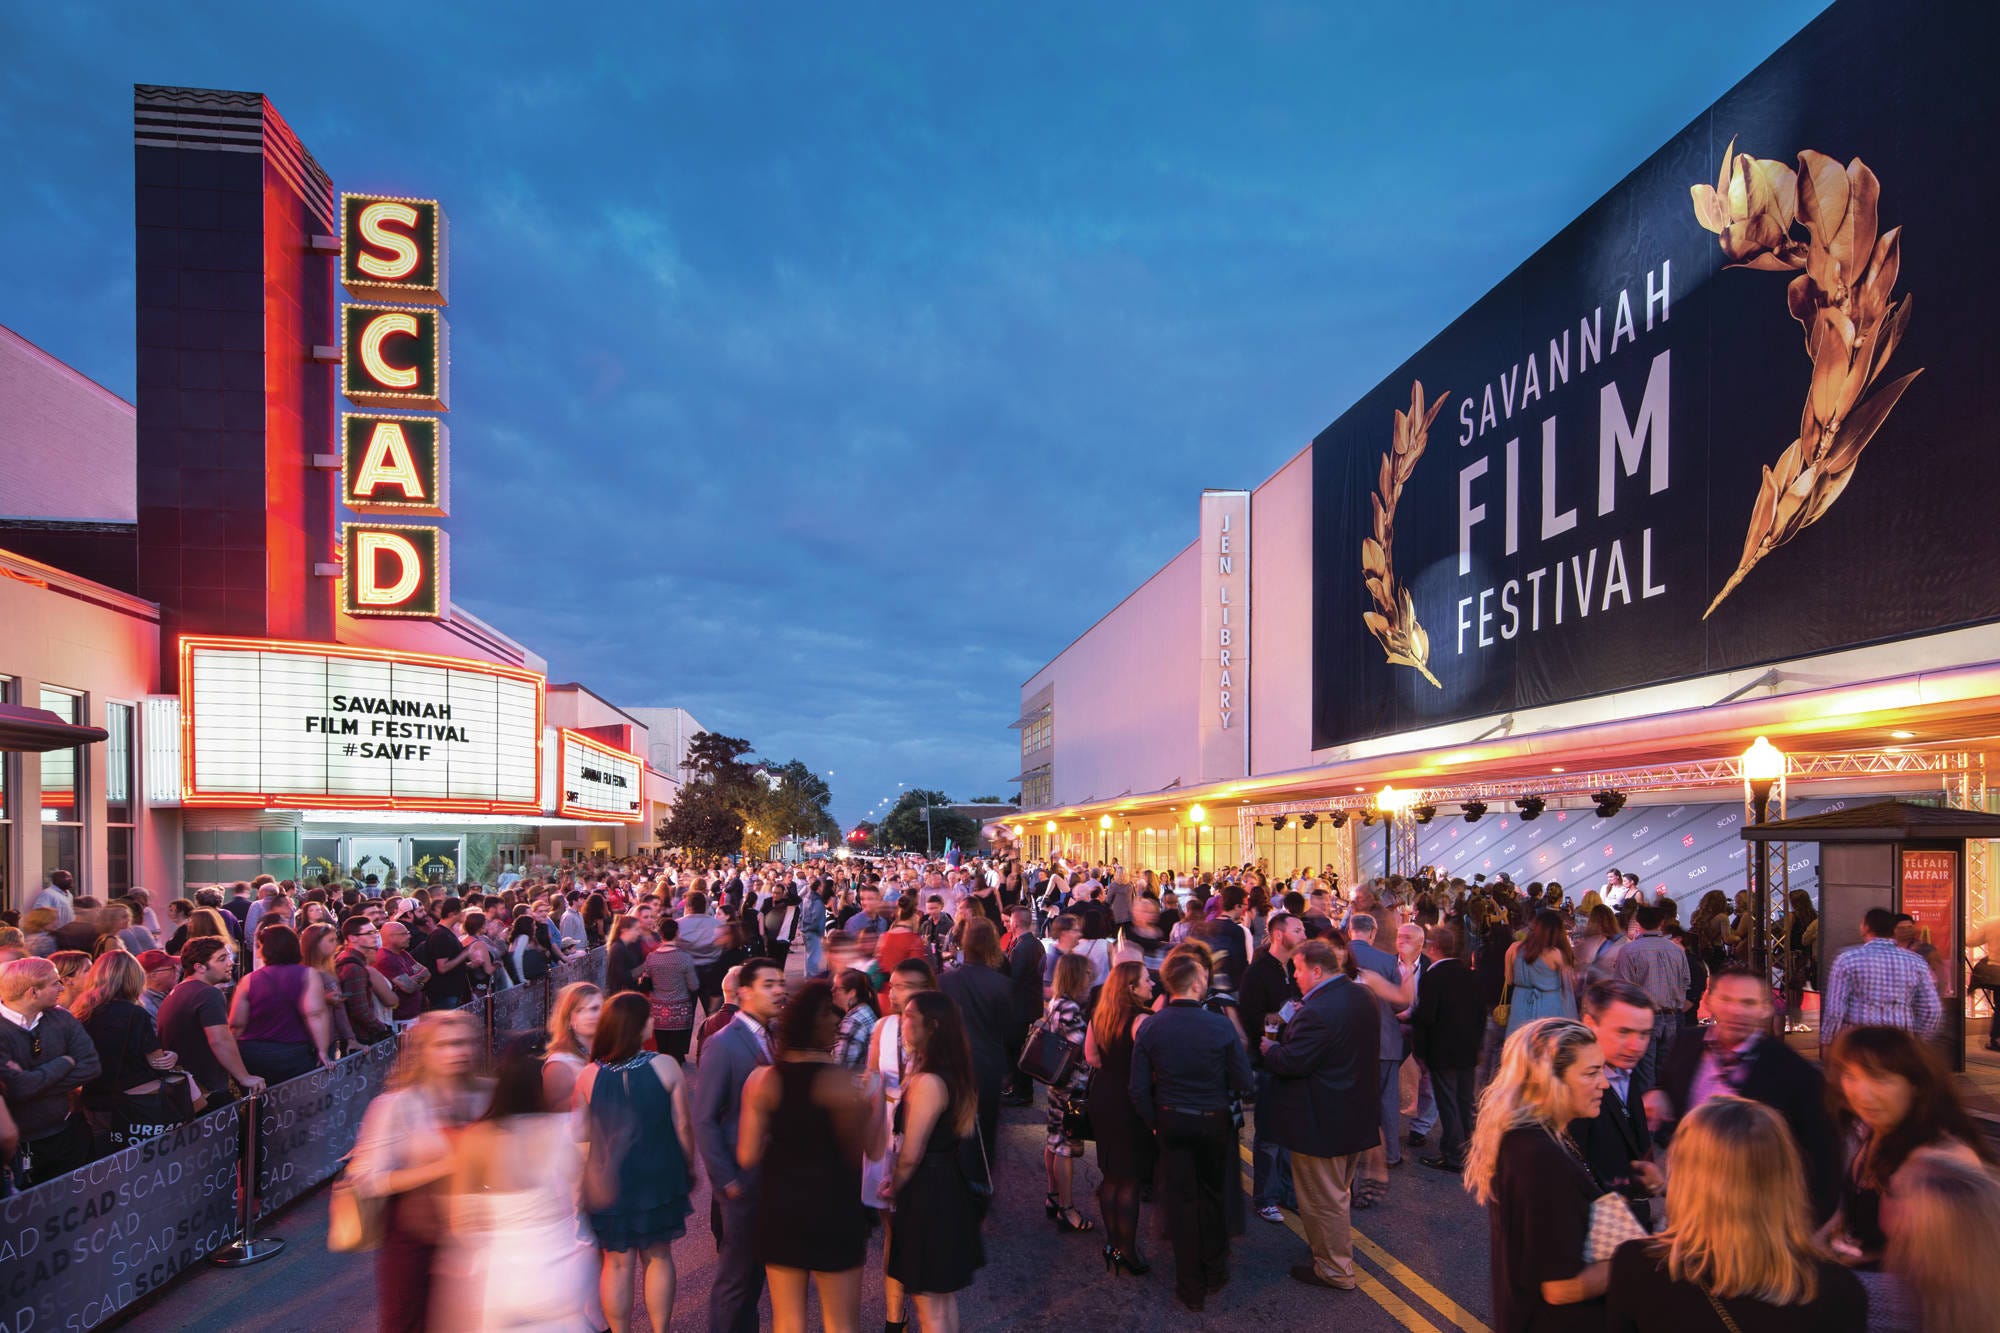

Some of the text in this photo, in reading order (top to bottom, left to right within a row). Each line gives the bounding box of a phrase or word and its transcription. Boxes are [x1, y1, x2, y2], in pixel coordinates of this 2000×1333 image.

[1458, 259, 1671, 447] SAVANNAH
[353, 202, 425, 605] SCAD
[1458, 348, 1671, 577] FILM
[1457, 527, 1666, 655] FESTIVAL
[1219, 514, 1232, 730] JEN LIBRARY
[333, 695, 452, 720] SAVANNAH
[306, 716, 470, 743] FILM FESTIVAL
[342, 742, 432, 761] #SAVFF
[1632, 826, 1649, 839] SCAD
[1716, 813, 1737, 828] SCAD
[1688, 865, 1708, 879] SCAD
[1788, 859, 1810, 873] SCAD
[1904, 859, 1949, 868] TELFAIR
[1905, 871, 1949, 880] ART FAIR
[261, 1109, 296, 1136] CAD
[4, 1105, 239, 1224] CAD SCAD SCAD SCA
[261, 1162, 294, 1191] CAD
[44, 1190, 116, 1242] SCAD
[118, 1161, 183, 1207] SCAD
[73, 1212, 140, 1263] SCAD
[203, 1163, 239, 1197] SCA
[112, 1226, 176, 1276] SCAD
